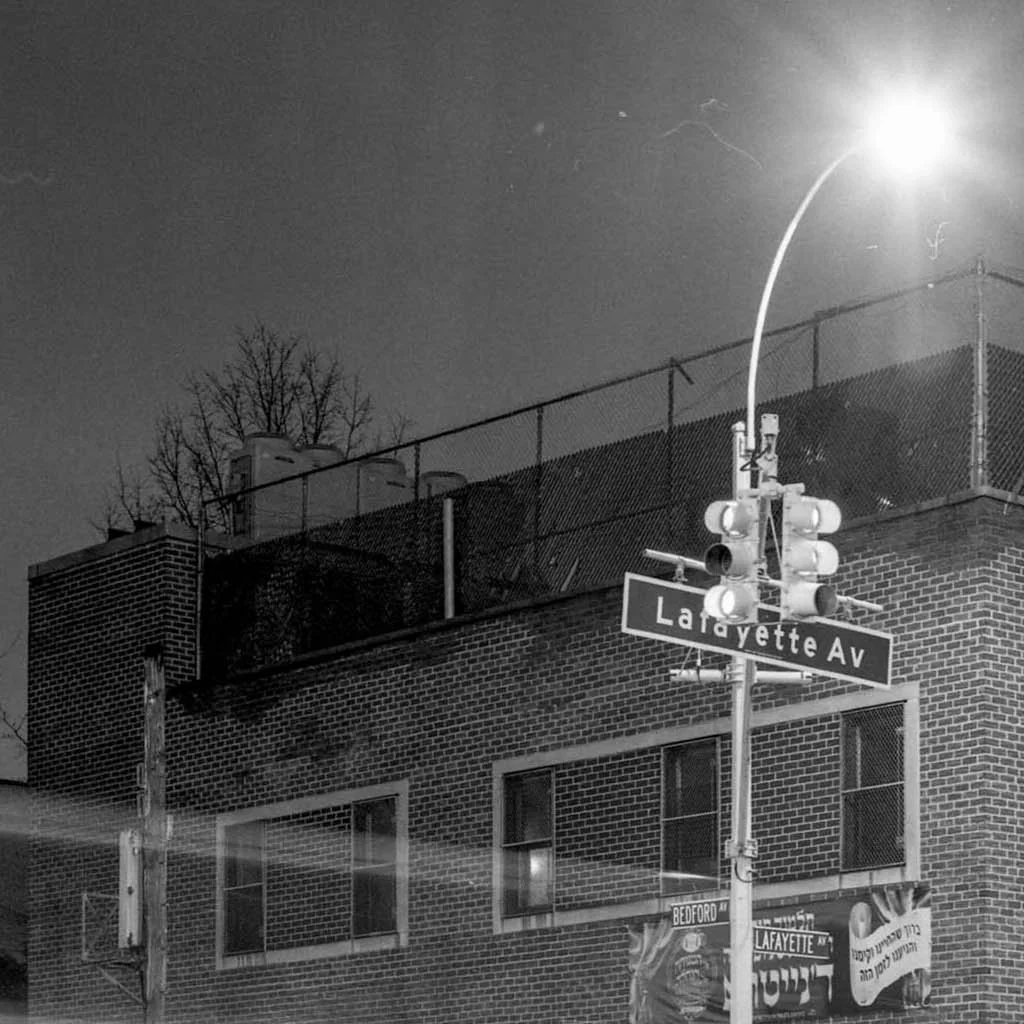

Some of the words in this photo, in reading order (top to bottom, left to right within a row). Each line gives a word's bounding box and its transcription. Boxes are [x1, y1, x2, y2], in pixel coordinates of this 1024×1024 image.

[655, 596, 818, 658] Lafayette
[826, 637, 865, 669] Av
[673, 903, 718, 926] BEDFORD
[755, 930, 814, 954] LAFAYETTE
